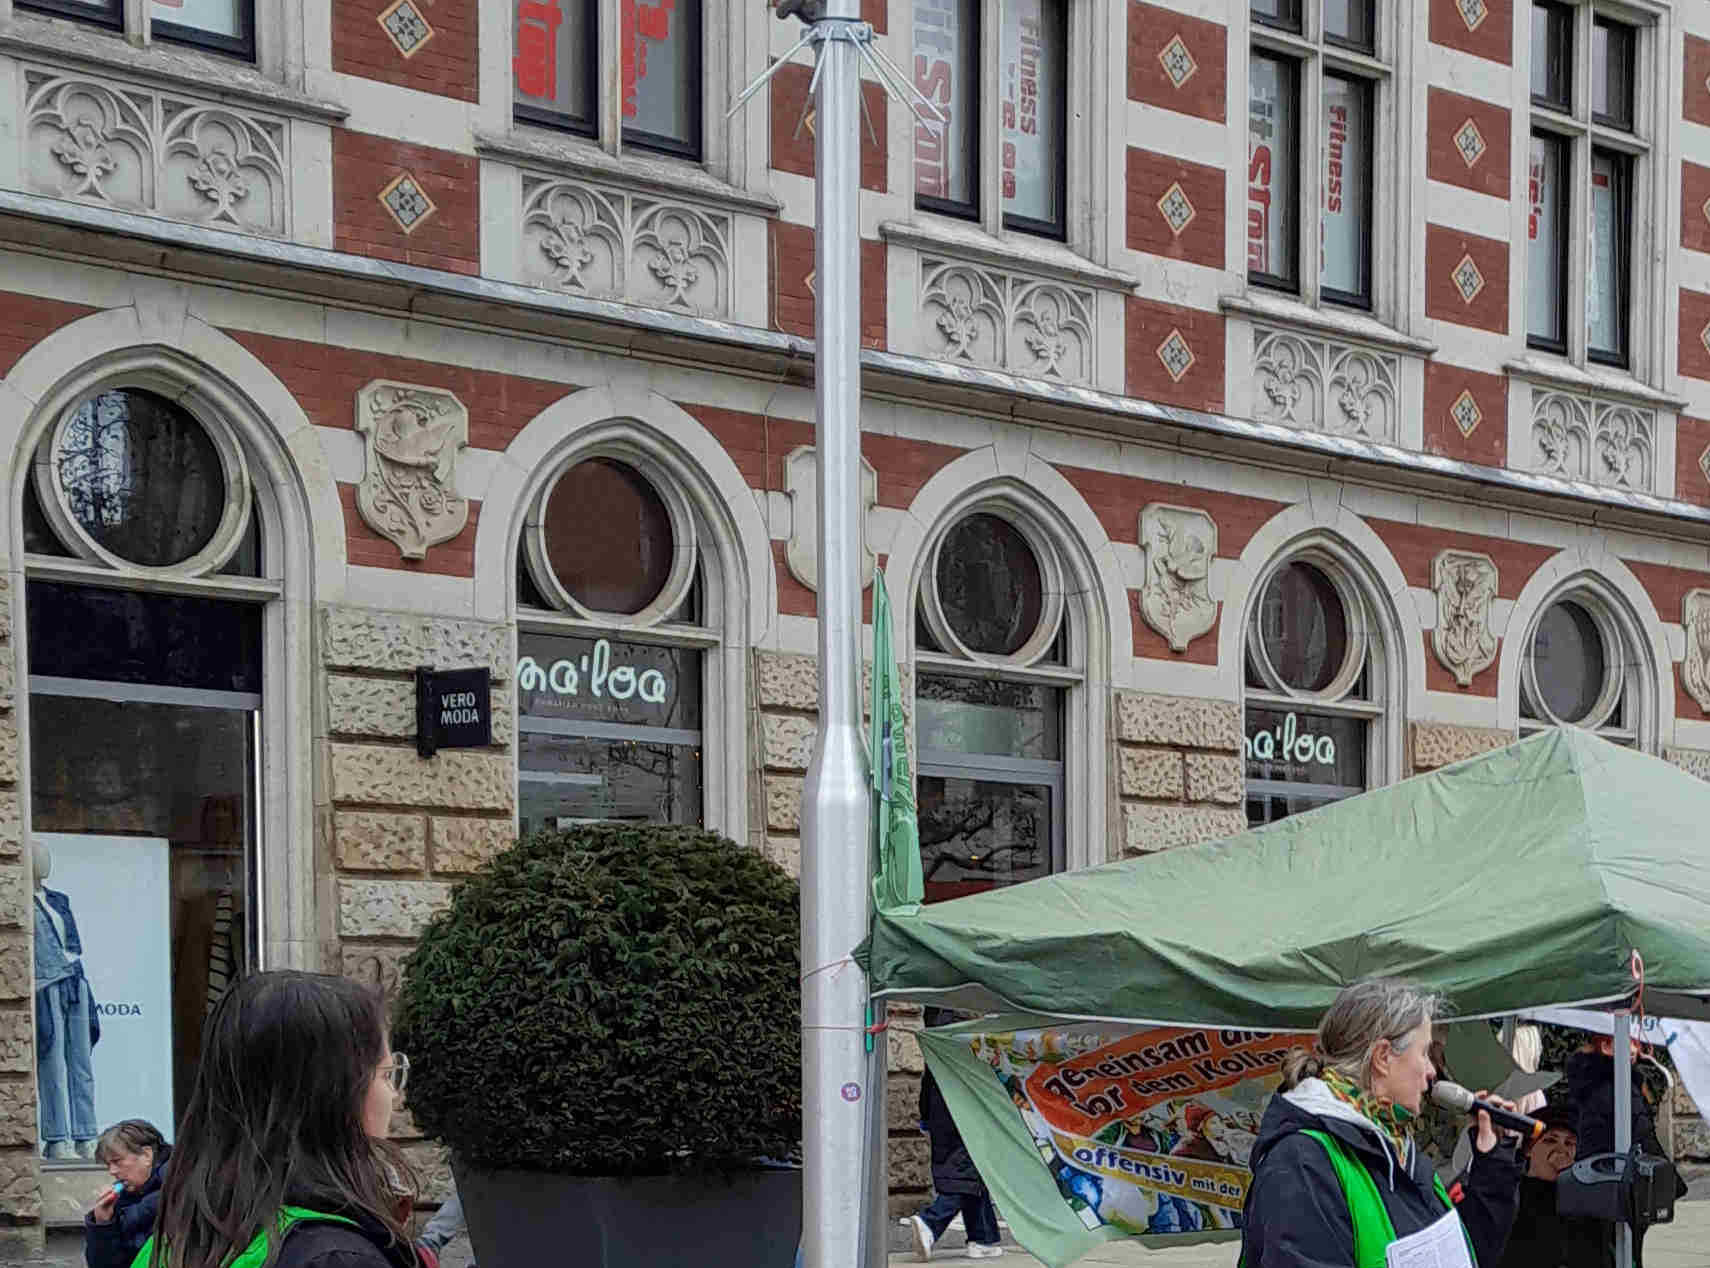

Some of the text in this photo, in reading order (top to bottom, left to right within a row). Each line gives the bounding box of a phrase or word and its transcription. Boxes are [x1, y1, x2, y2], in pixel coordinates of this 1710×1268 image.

[1328, 105, 1347, 214] Fitness
[440, 692, 476, 707] VERO
[440, 707, 480, 725] MODA
[1131, 1070, 1193, 1098] dem
[1073, 1146, 1241, 1197] offensiv mit der
